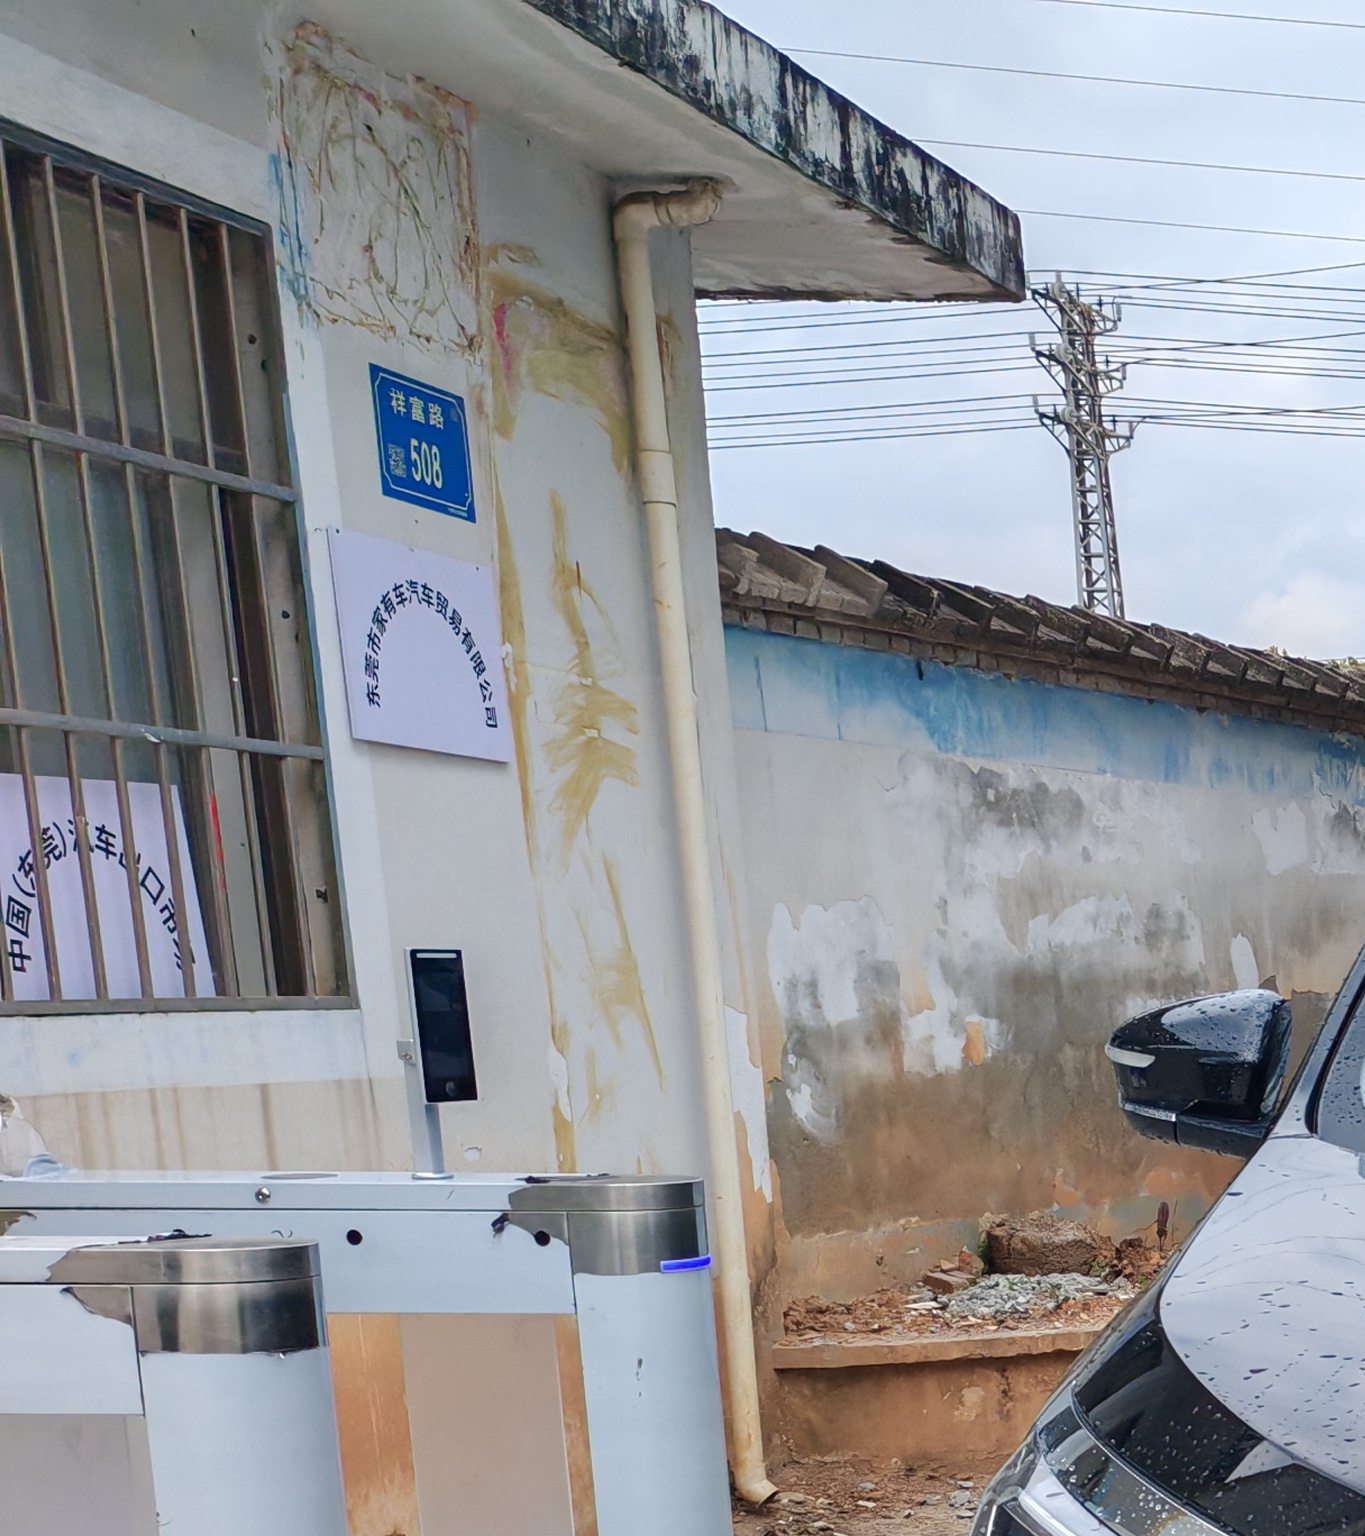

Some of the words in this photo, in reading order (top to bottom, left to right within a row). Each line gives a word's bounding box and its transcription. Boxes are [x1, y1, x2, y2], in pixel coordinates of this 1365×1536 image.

[388, 387, 446, 430] 祥富路
[410, 437, 443, 489] 508
[364, 579, 498, 729] 东莞市家有车汽车贸易有限公司
